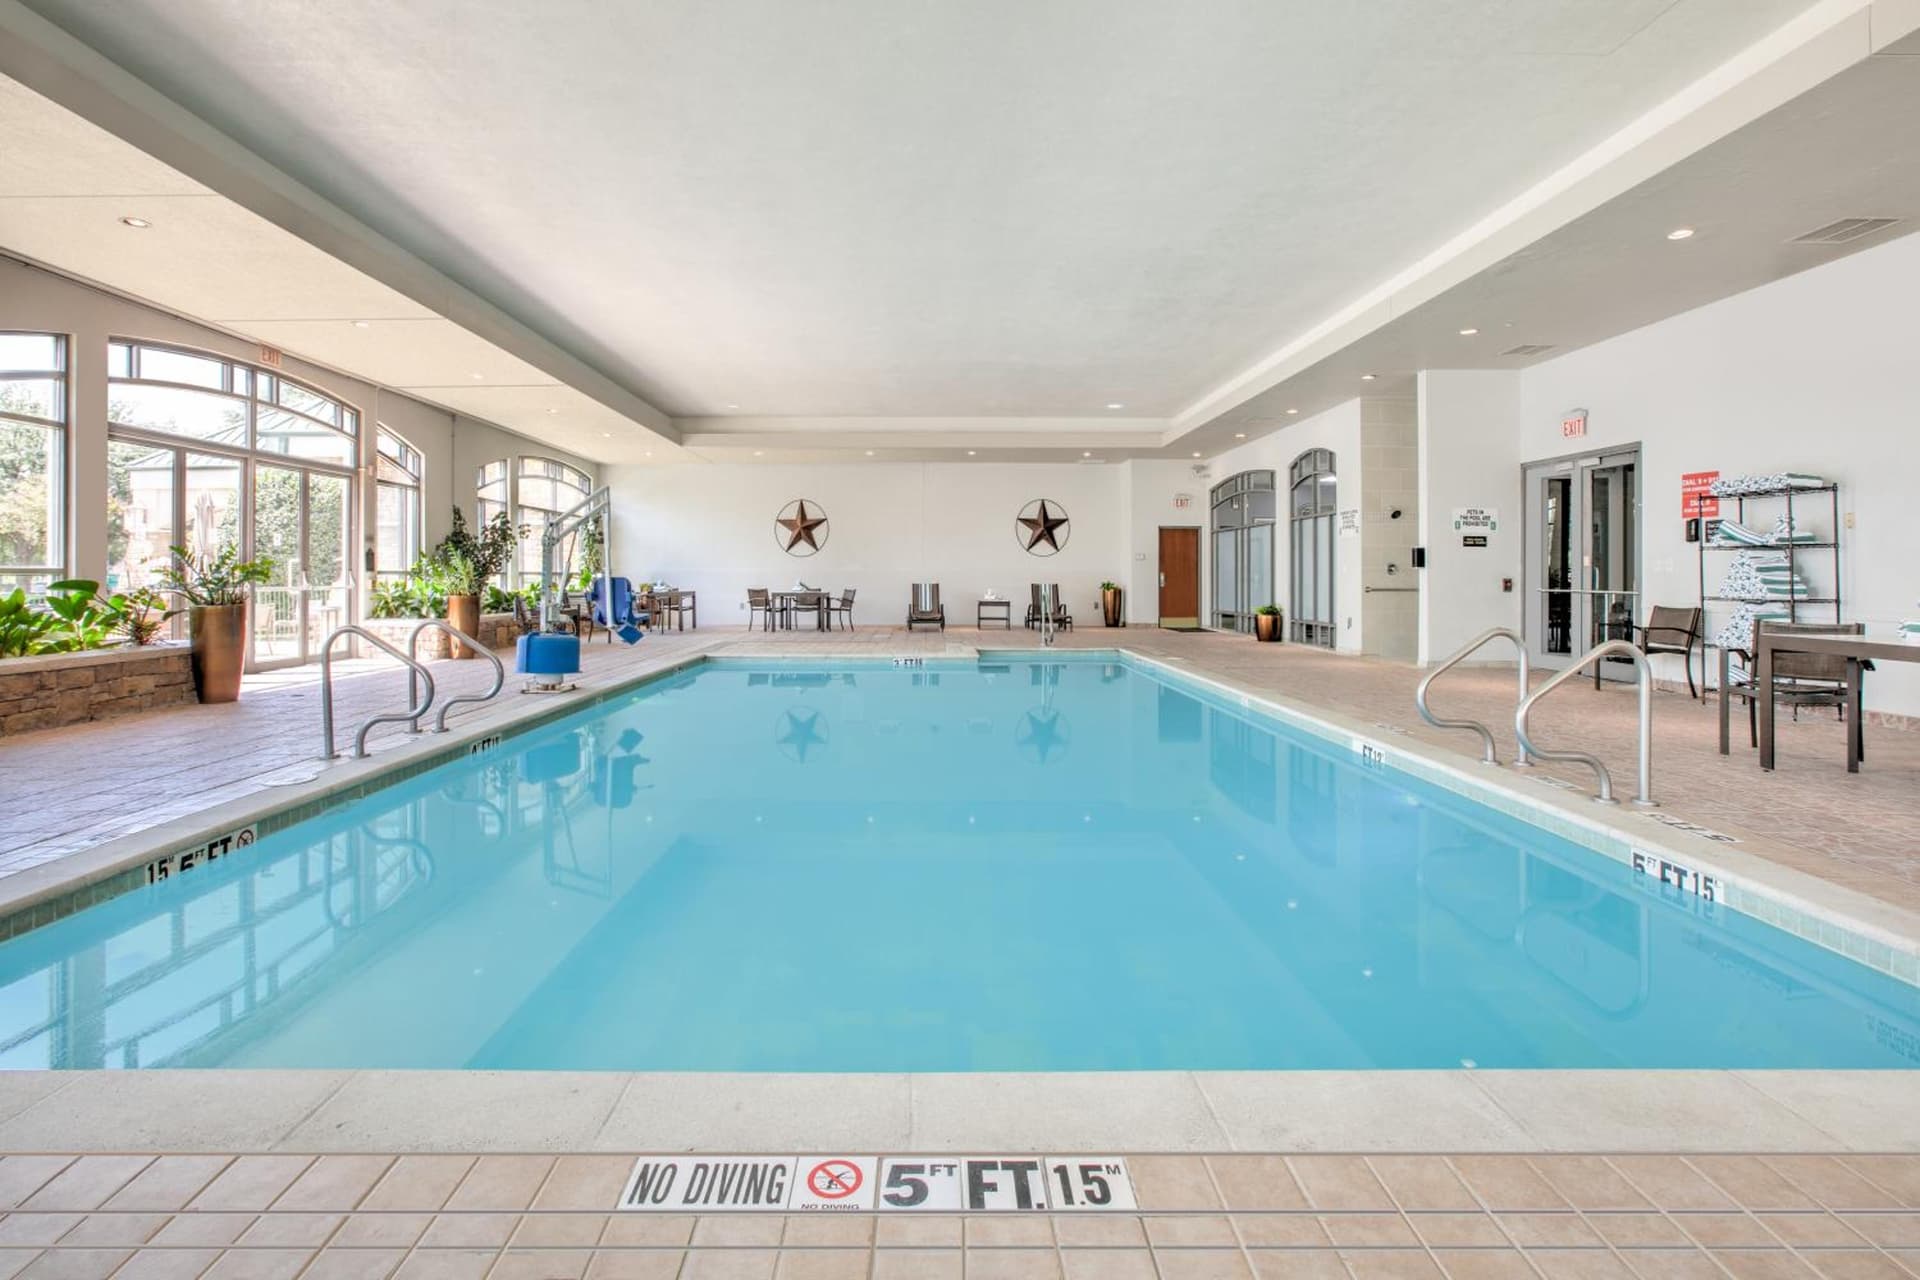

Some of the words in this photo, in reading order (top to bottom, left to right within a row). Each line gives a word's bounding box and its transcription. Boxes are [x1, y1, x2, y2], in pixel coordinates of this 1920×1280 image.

[1563, 418, 1582, 437] EXIT
[626, 1162, 678, 1206] NO
[681, 1162, 787, 1206] DIVING
